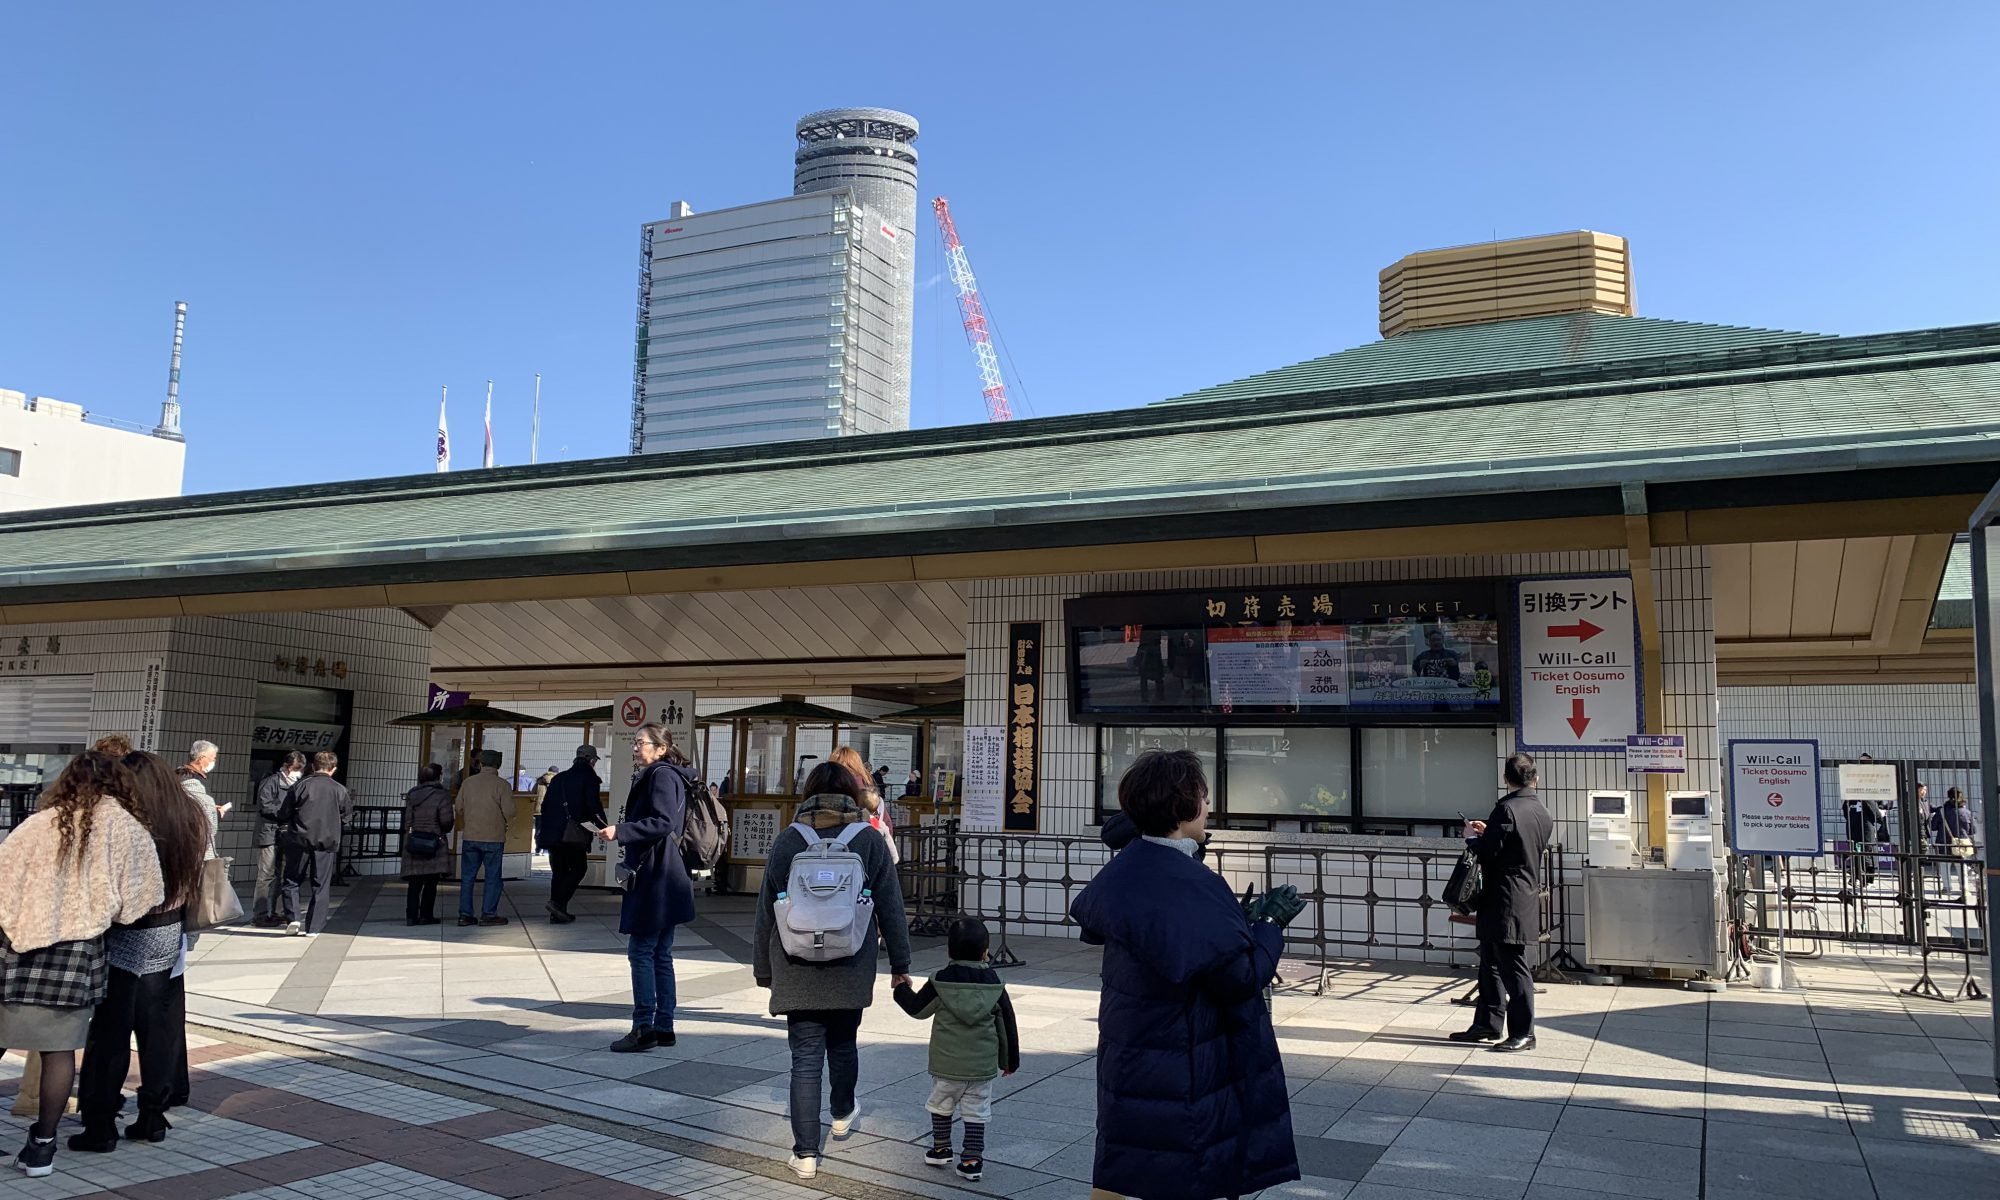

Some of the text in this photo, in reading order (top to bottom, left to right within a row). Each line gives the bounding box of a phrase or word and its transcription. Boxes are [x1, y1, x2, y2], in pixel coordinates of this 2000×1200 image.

[1205, 593, 1334, 618] 切符売場
[1371, 601, 1462, 615] TICKET
[1524, 591, 1628, 613] 引換テント
[1313, 650, 1331, 659] 大人
[1538, 652, 1616, 665] Will-Call
[1314, 676, 1333, 685] 子供
[1531, 671, 1625, 681] Ticket Oosumo
[1310, 685, 1339, 694] 200円
[1555, 684, 1601, 696] English
[429, 690, 450, 711] 所
[252, 726, 335, 747] 案内所受付
[1637, 737, 1674, 746] Will-Call
[1010, 682, 1035, 814] 日本相撲協会
[1282, 739, 1290, 751] 2
[1423, 740, 1430, 752] 1
[1746, 755, 1801, 765] Will-Call
[1770, 768, 1808, 776] Oosumo
[1758, 777, 1791, 786] English
[750, 813, 759, 840] の入場は
